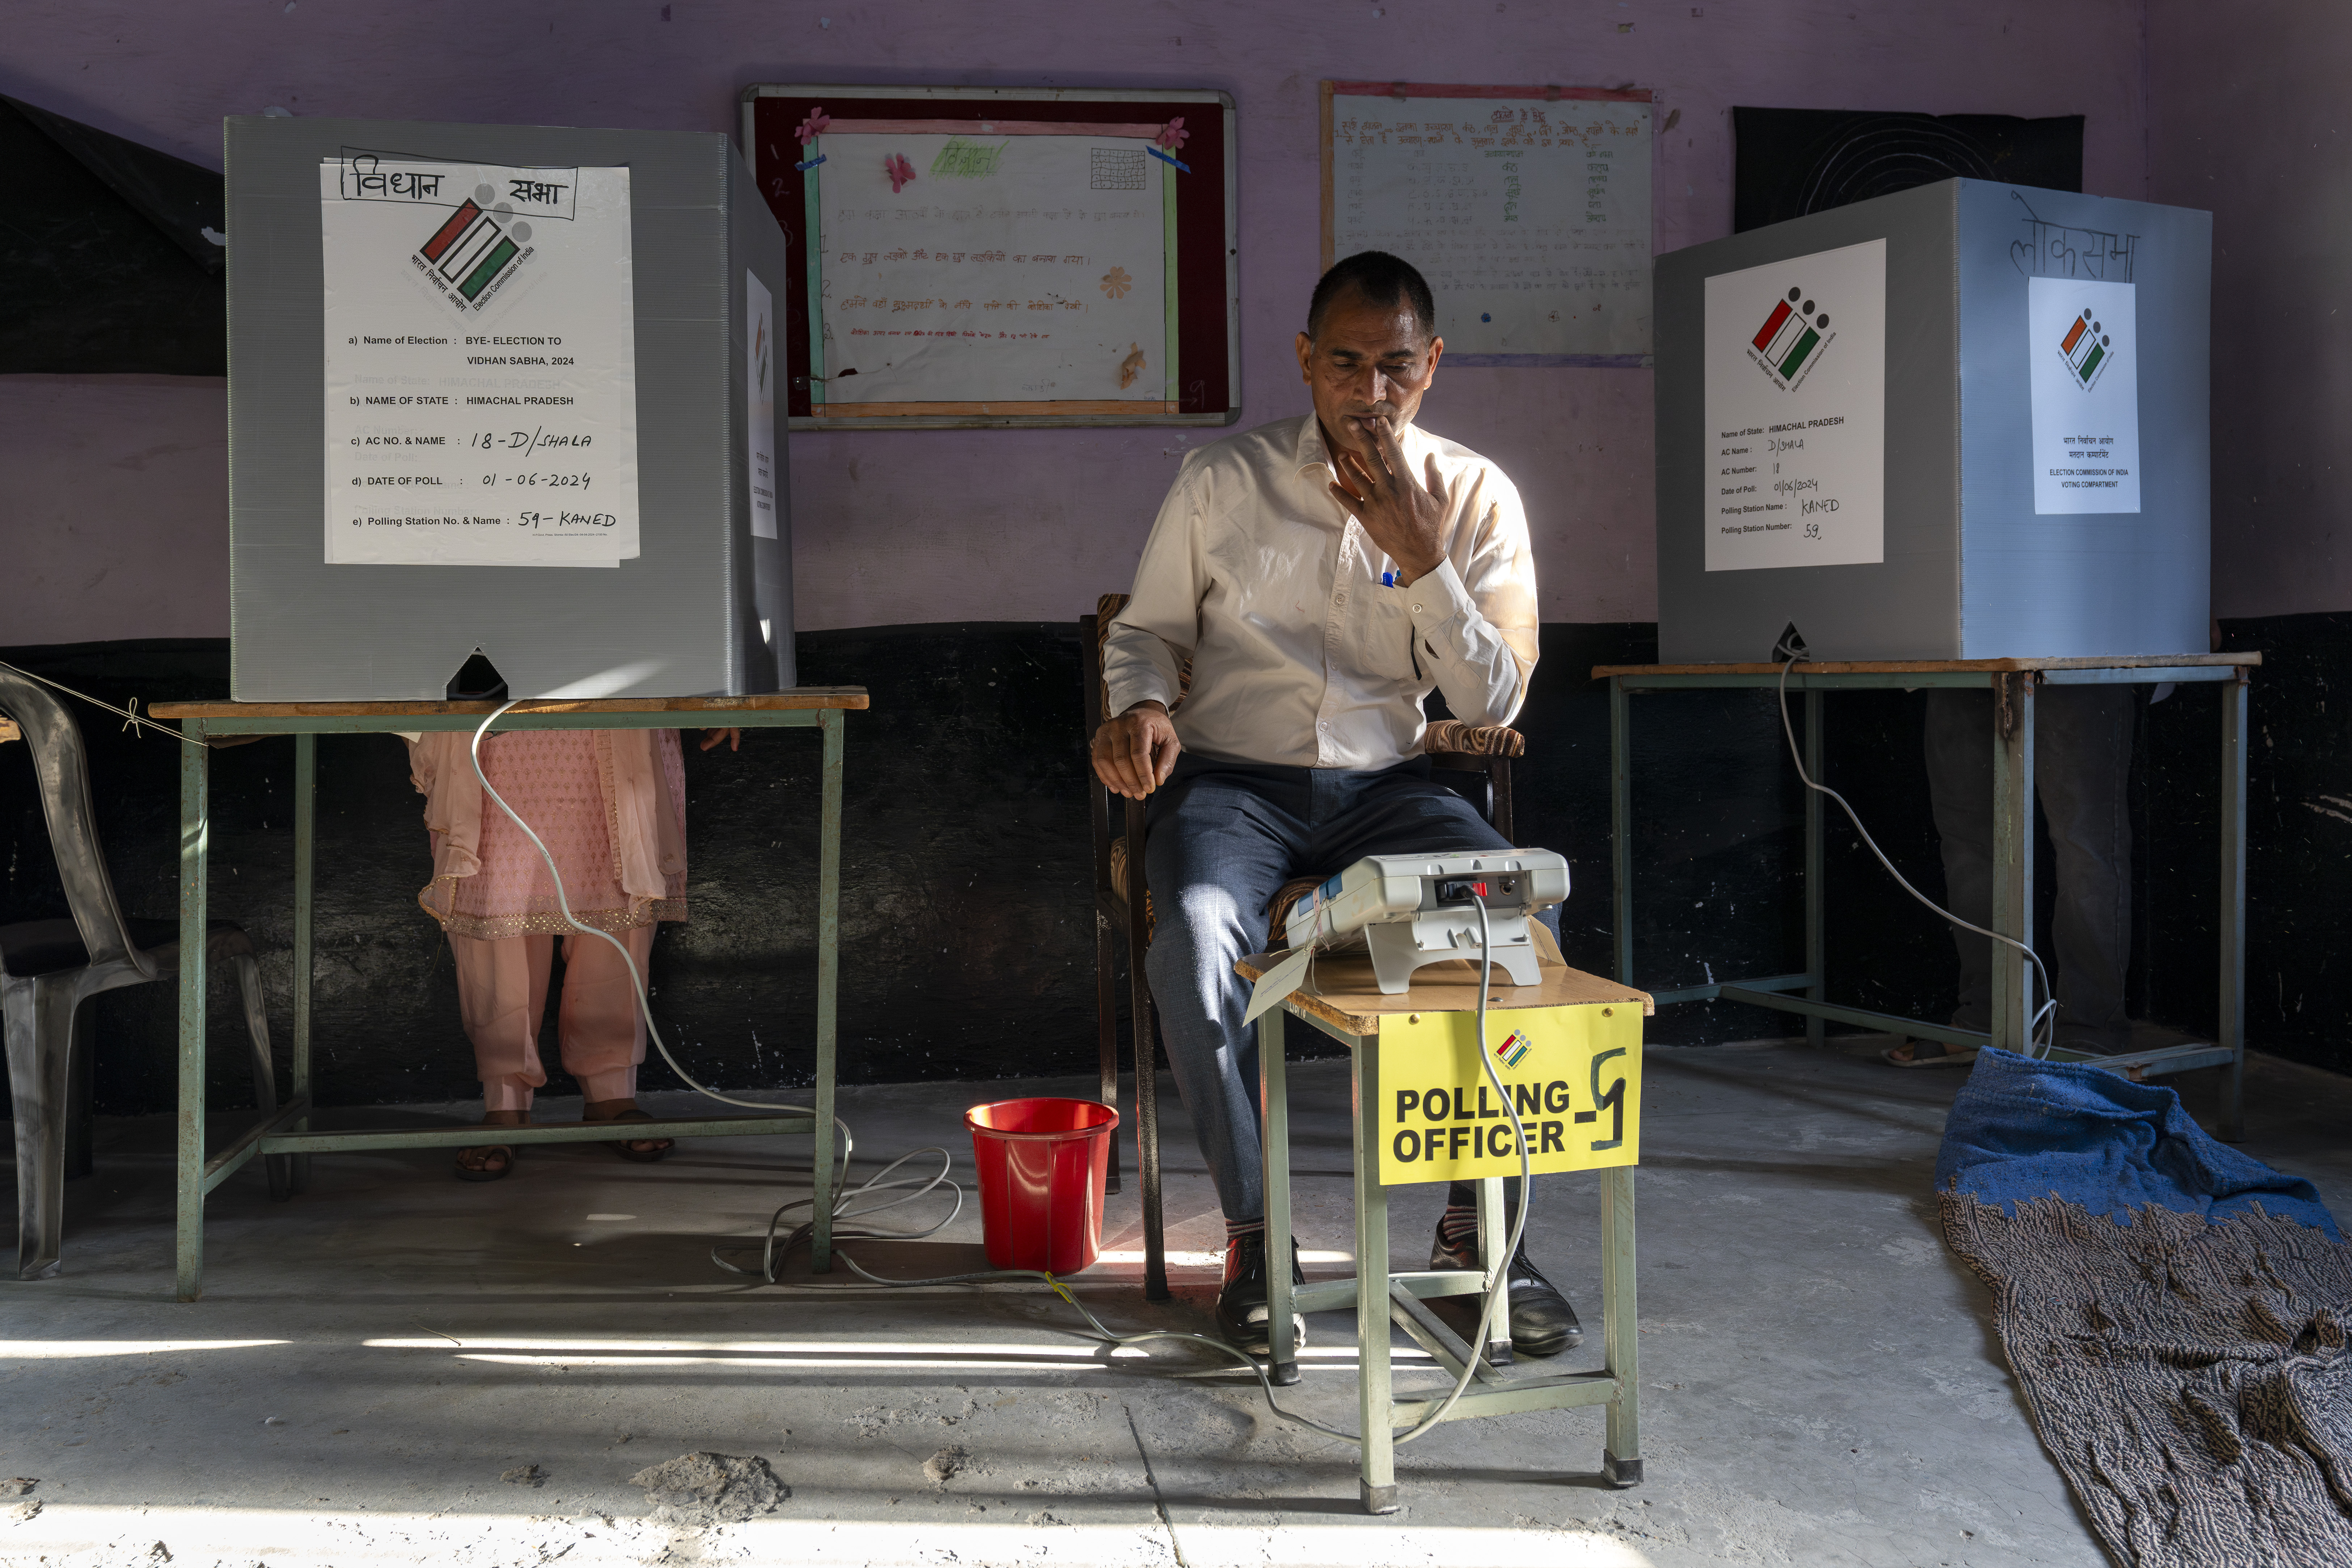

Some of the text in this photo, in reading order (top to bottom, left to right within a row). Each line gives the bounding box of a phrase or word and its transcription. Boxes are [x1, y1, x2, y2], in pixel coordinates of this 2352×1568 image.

[350, 155, 569, 205] विधान सभा
[412, 254, 467, 312] भारत निर्वाचन आयोग
[473, 291, 493, 311] Election
[490, 264, 518, 293] Commission
[520, 246, 535, 260] India
[349, 336, 357, 346] a)
[510, 357, 548, 366] SABHA,
[1792, 374, 1806, 392] Election
[1804, 347, 1824, 375] Commission
[1827, 332, 1836, 344] India
[1747, 348, 1786, 392] भारत निर्वाचन आयोग
[350, 397, 359, 406] b)
[1769, 422, 1806, 433] HIMACHAL
[1809, 417, 1844, 428] PRADESH
[351, 437, 360, 447] c)
[2078, 435, 2096, 444] निर्वाचन
[2099, 435, 2114, 444] आयोग
[2086, 449, 2109, 458] कम्पार्टमेंट
[352, 477, 361, 487] d)
[1774, 478, 1818, 498] 01/06/2024
[1802, 499, 1839, 516] KANED
[353, 517, 361, 527] e)
[368, 517, 402, 527] Polling
[1397, 1081, 1569, 1123] POLLING
[1393, 1121, 1565, 1163] OFFICER
